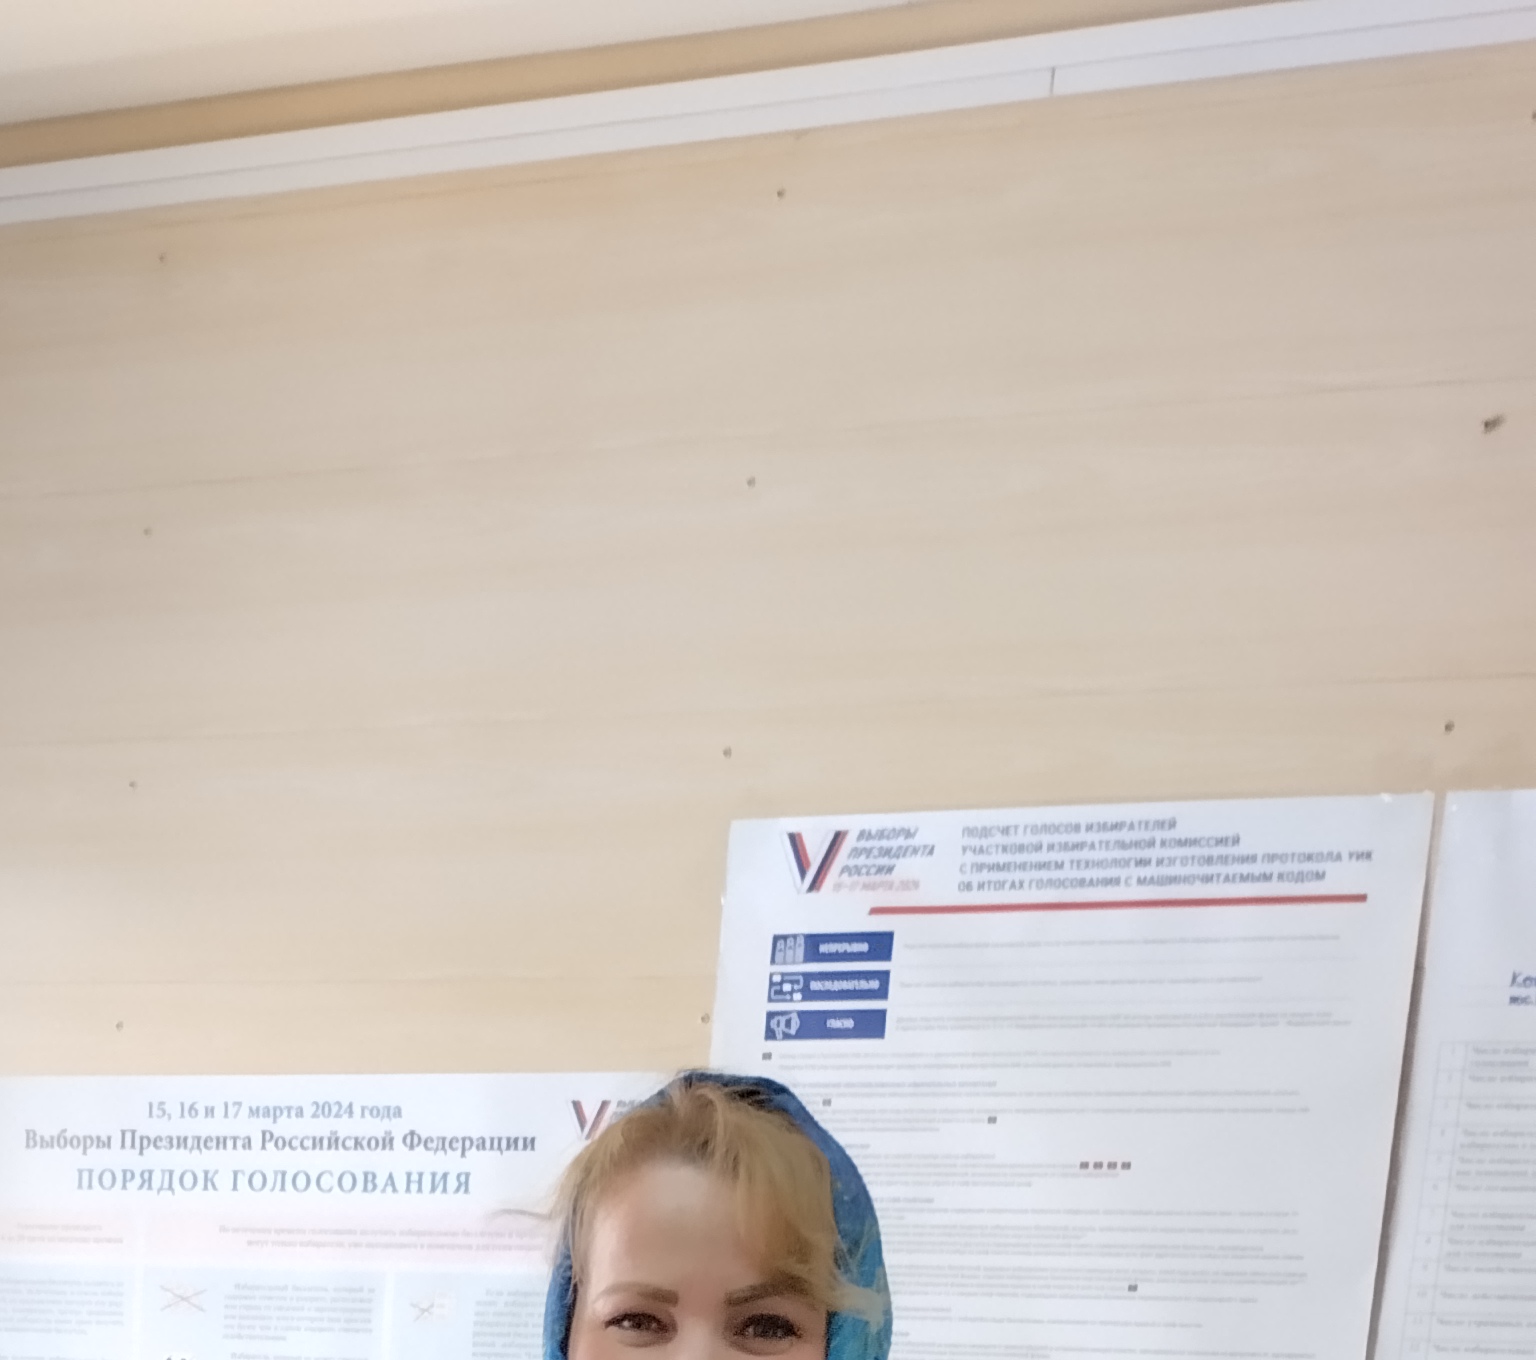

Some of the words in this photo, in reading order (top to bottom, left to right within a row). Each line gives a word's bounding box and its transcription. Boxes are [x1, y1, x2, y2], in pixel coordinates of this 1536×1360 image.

[856, 827, 918, 842] ВЫБОРЫ
[1023, 822, 1081, 836] ГОЛОСОВ
[1085, 817, 1177, 833] ИЗБИРАТЕЛЕЙ
[847, 844, 935, 860] ПРЕЗИДЕНТА
[962, 840, 1043, 856] УЧАСТКОВОЙ
[1047, 836, 1156, 853] ИЗБИРАТЕЛЬНОЙ
[1160, 833, 1240, 849] КОМИССИЕЙ
[839, 864, 896, 878] РОССИИ
[147, 1101, 172, 1121] 15,
[178, 1101, 199, 1119] 16
[203, 1104, 215, 1119] и
[222, 1101, 243, 1119] 17
[247, 1103, 304, 1124] марта
[310, 1101, 354, 1119] 2024
[360, 1103, 403, 1122] года
[24, 1128, 112, 1156] Выборы
[120, 1129, 252, 1156] Президента
[261, 1129, 394, 1151] Российской
[402, 1129, 536, 1158] Федерации
[76, 1168, 219, 1196] ПОРЯДОК
[232, 1169, 471, 1195] ГОЛОСОВАНИЯ
